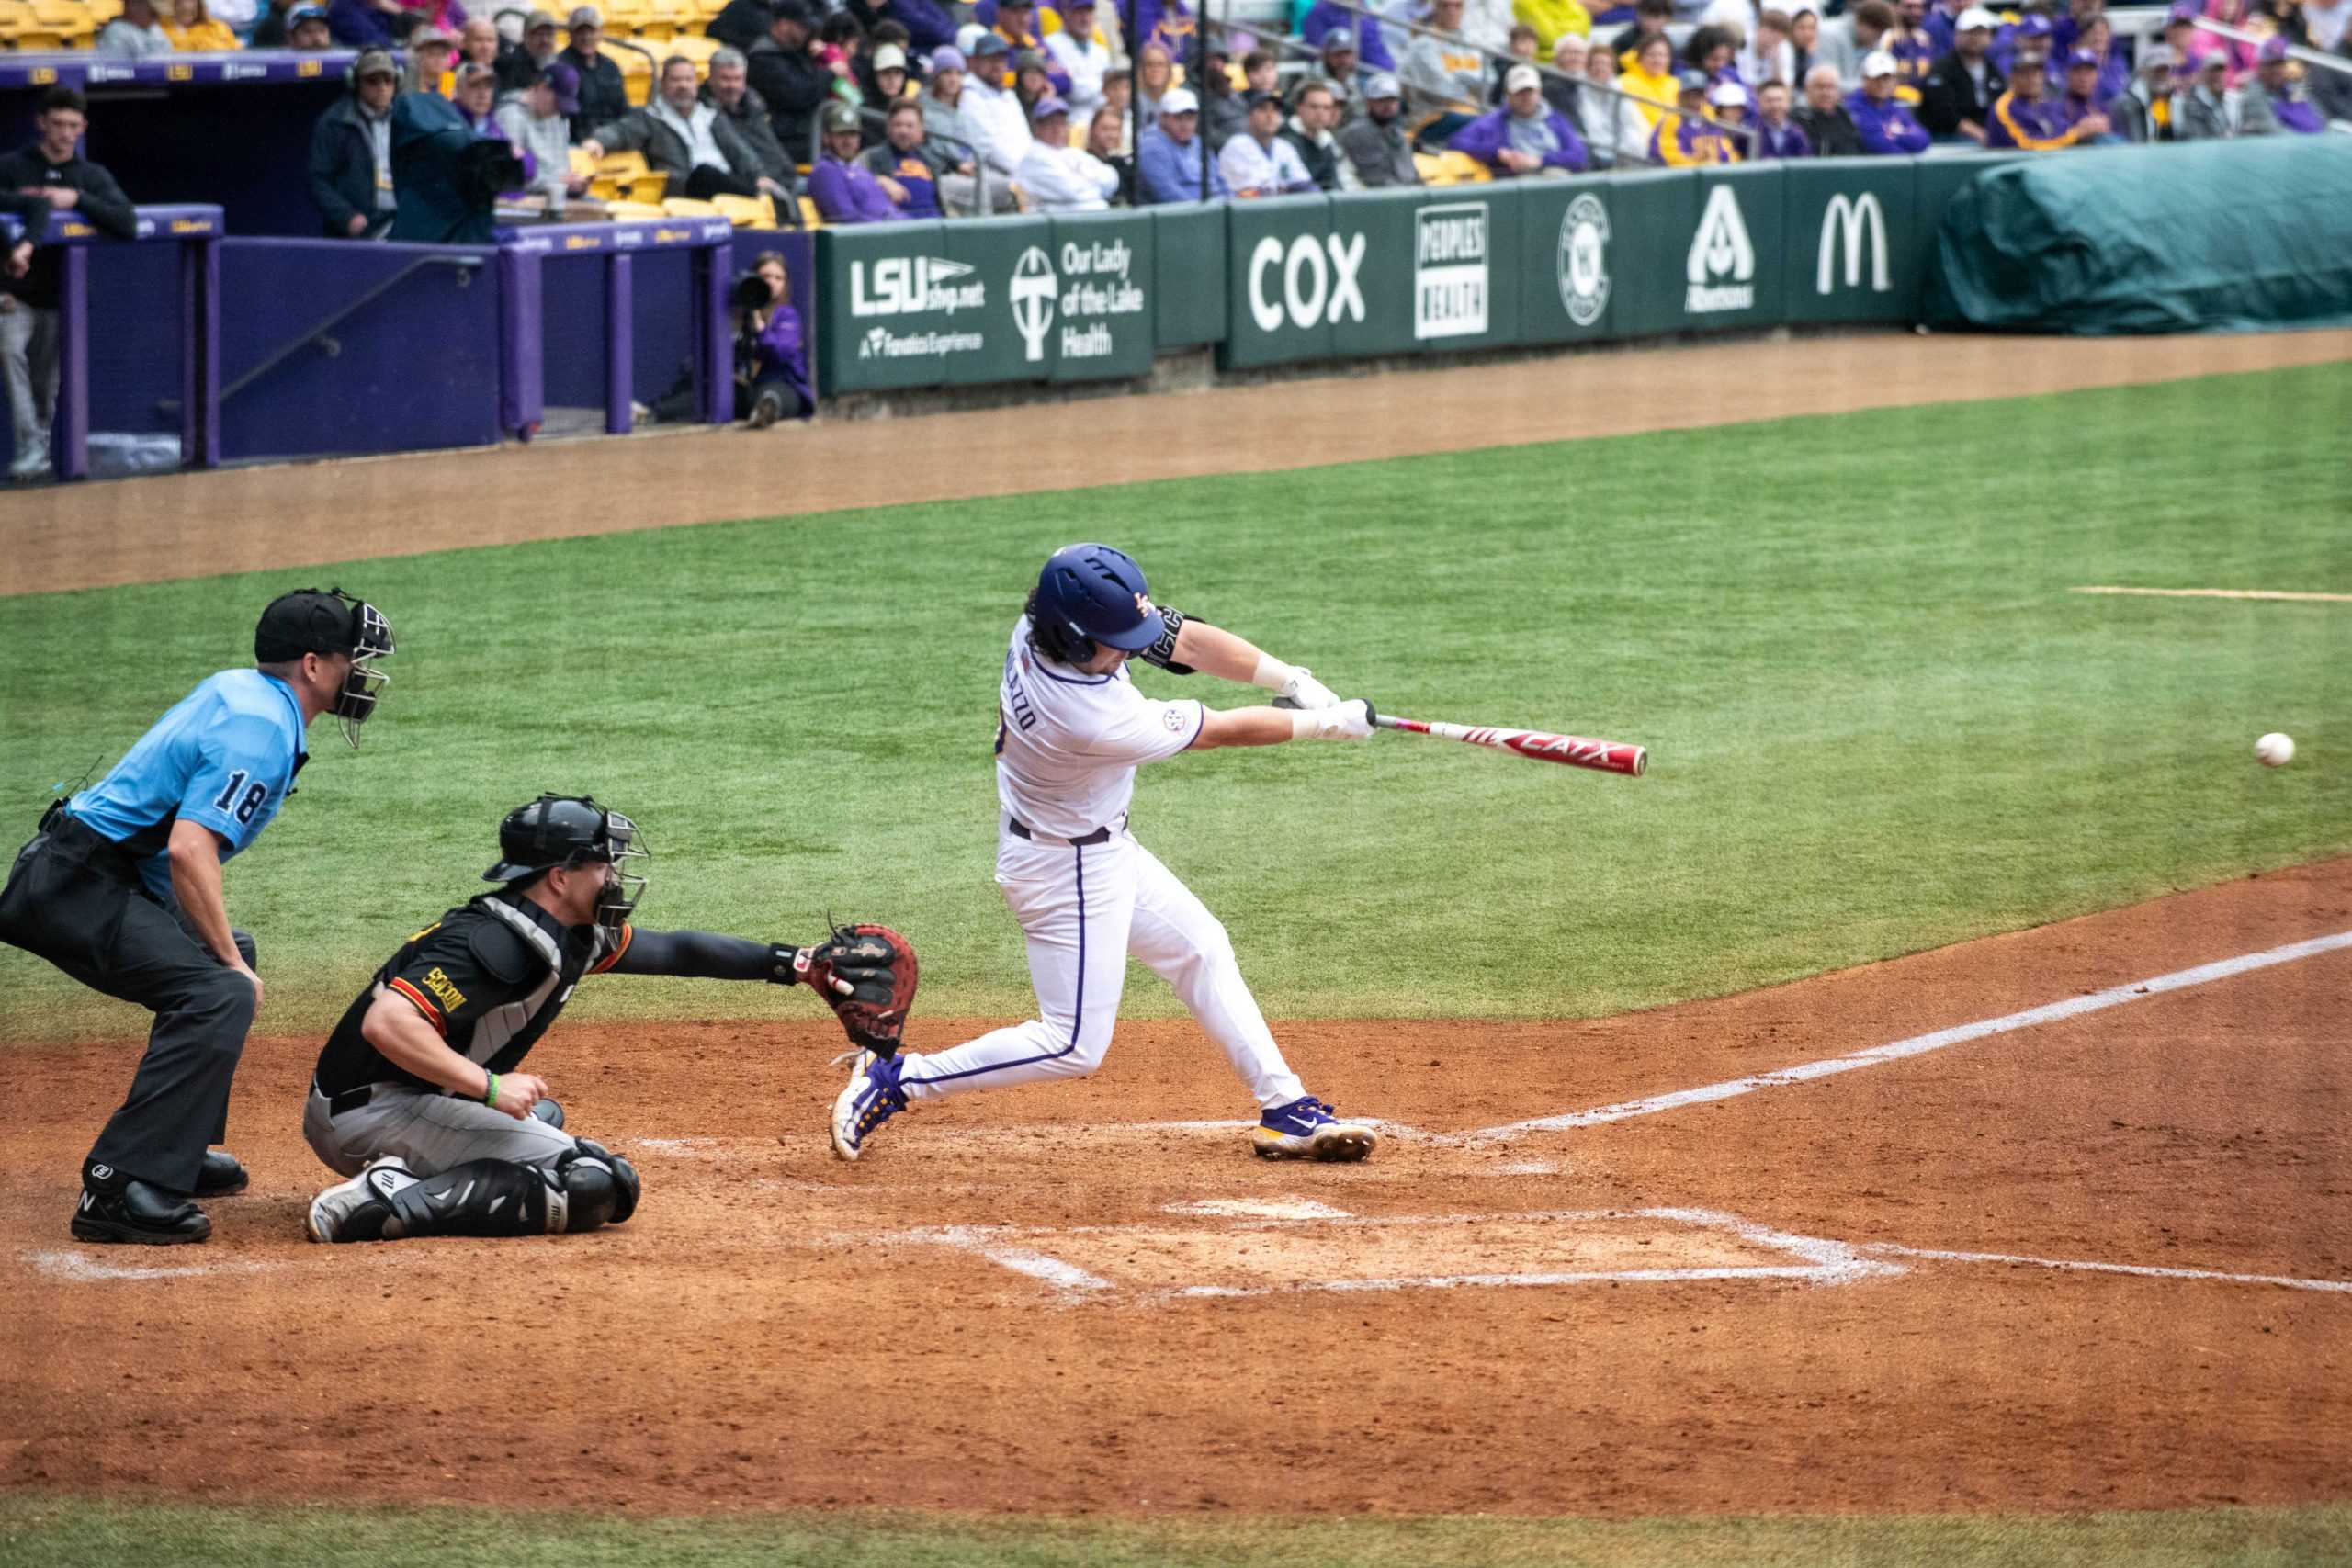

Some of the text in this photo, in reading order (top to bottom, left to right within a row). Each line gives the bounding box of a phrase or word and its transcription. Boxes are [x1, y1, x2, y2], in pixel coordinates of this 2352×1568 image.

[1061, 238, 1131, 280] Our Lady
[851, 256, 928, 317] LSU
[1061, 278, 1144, 317] of the Lake
[1248, 232, 1366, 332] COX
[1061, 321, 1112, 358] Health
[1520, 733, 1624, 763] CATX
[213, 769, 268, 825] 18
[422, 966, 467, 1014] SOCON
